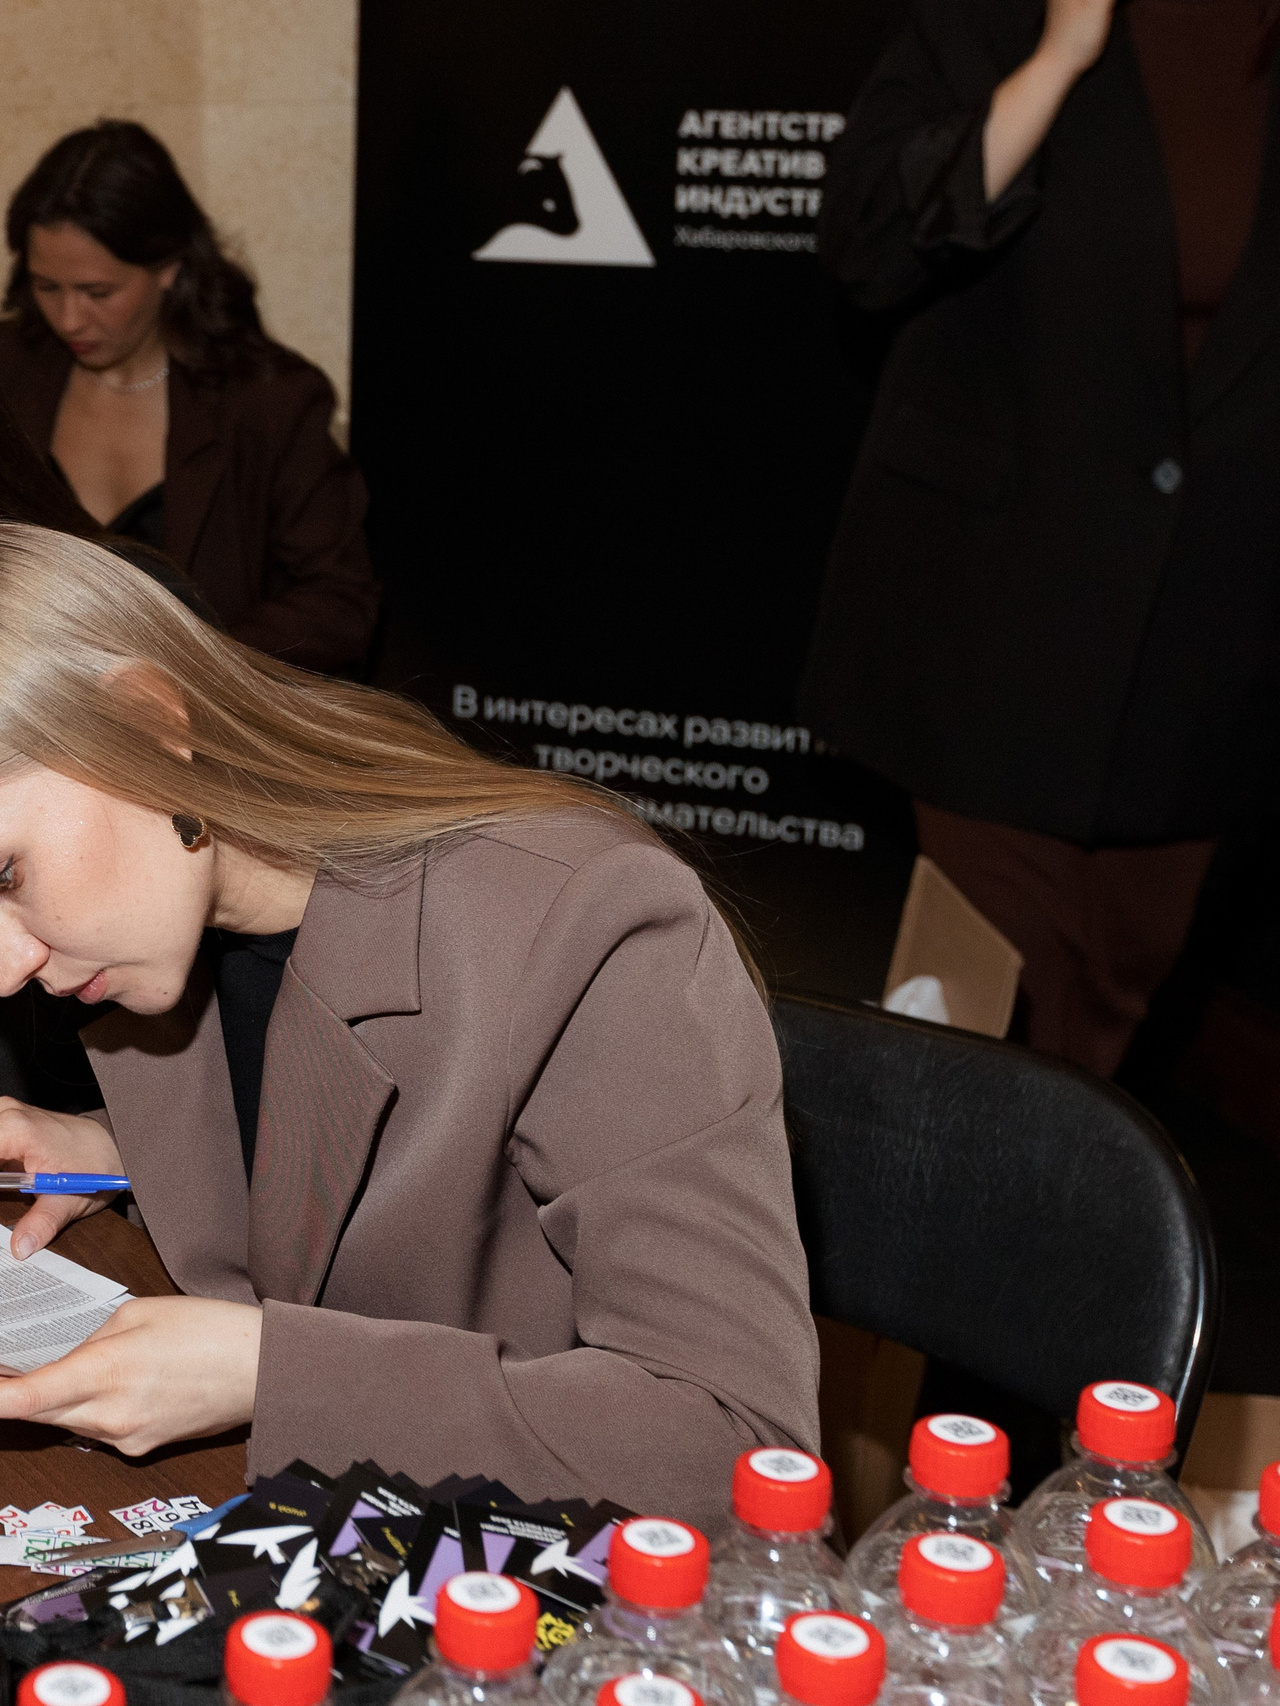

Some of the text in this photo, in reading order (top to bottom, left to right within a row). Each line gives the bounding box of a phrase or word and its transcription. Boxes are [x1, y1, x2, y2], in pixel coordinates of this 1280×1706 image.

[677, 109, 846, 142] АГЕНТСТР
[676, 147, 826, 180] КРЕАТИВ
[453, 684, 478, 718] В
[483, 695, 679, 740] интересах
[533, 744, 770, 795] творческого
[115, 1500, 167, 1521] 232
